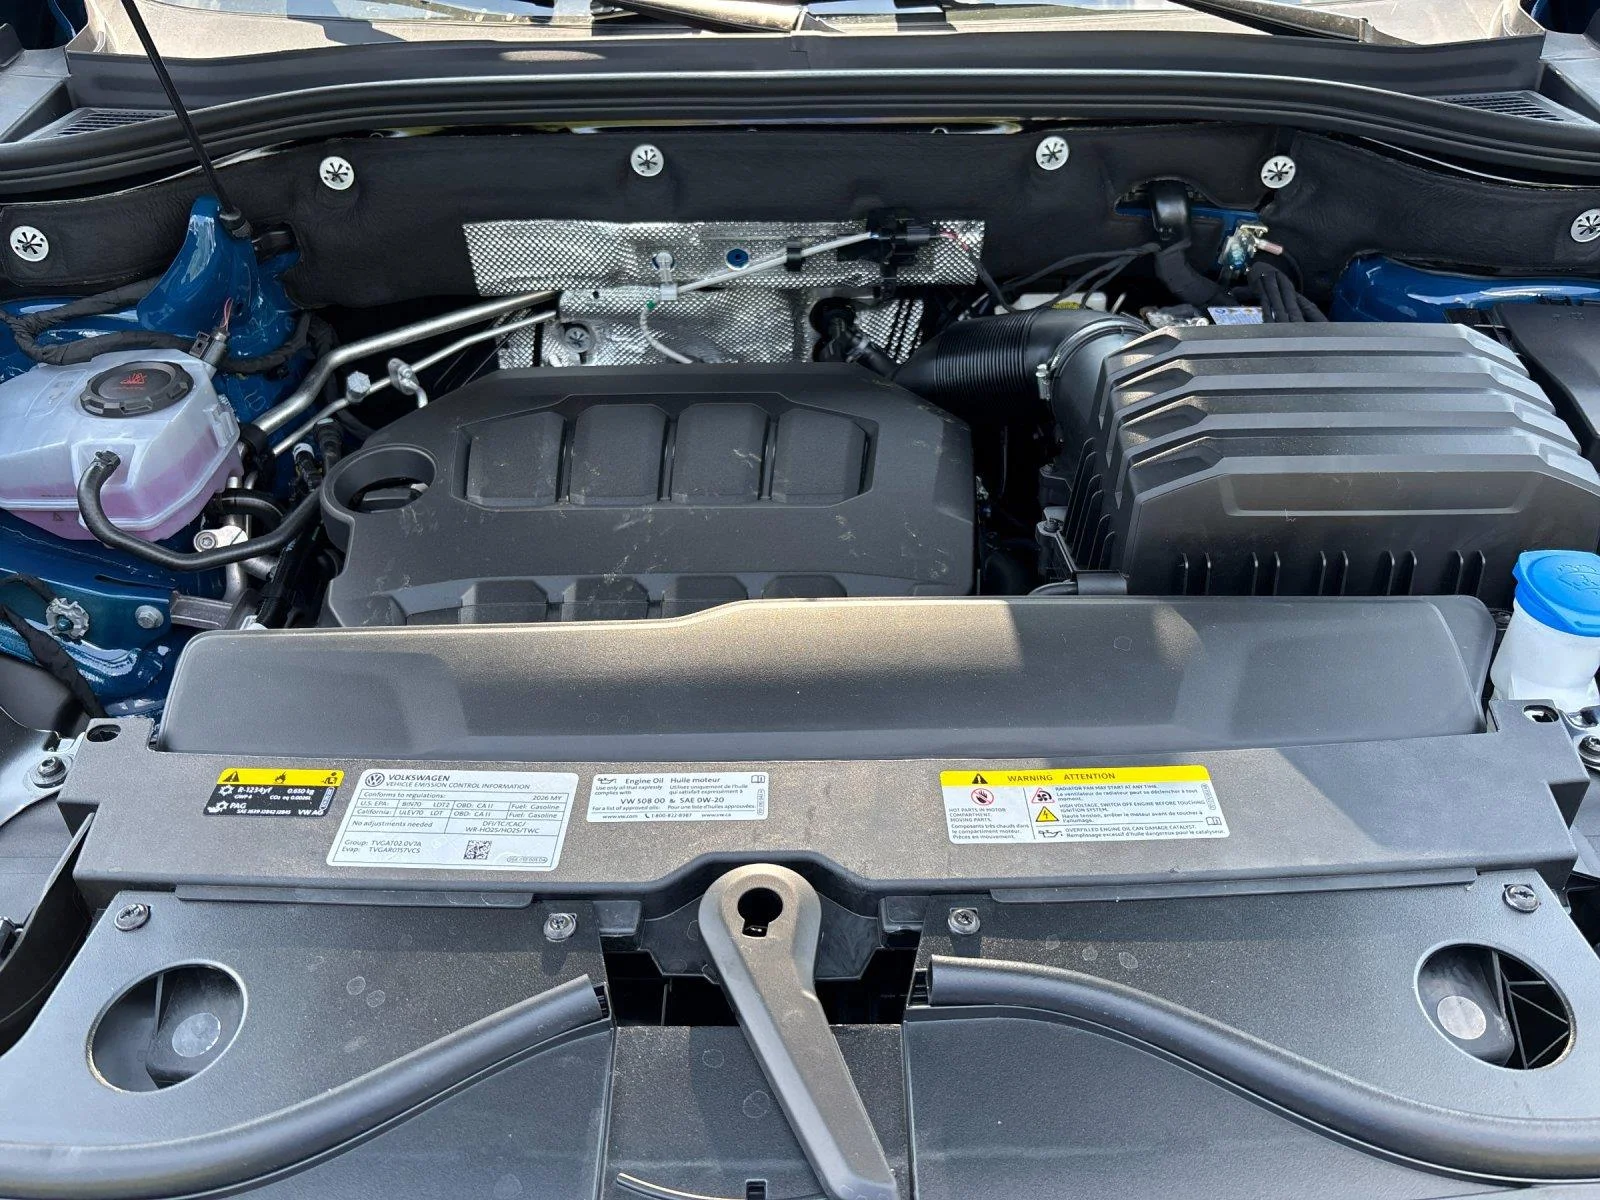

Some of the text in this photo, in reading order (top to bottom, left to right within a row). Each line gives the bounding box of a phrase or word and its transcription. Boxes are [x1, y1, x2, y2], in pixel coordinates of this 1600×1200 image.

[388, 774, 450, 782] VOLKSWAGEN
[1007, 773, 1116, 782] WARNING ATTENTION
[625, 778, 652, 786] Engine
[237, 786, 272, 794] R-1234yf
[406, 792, 446, 800] regulations:
[344, 839, 369, 847] Group:
